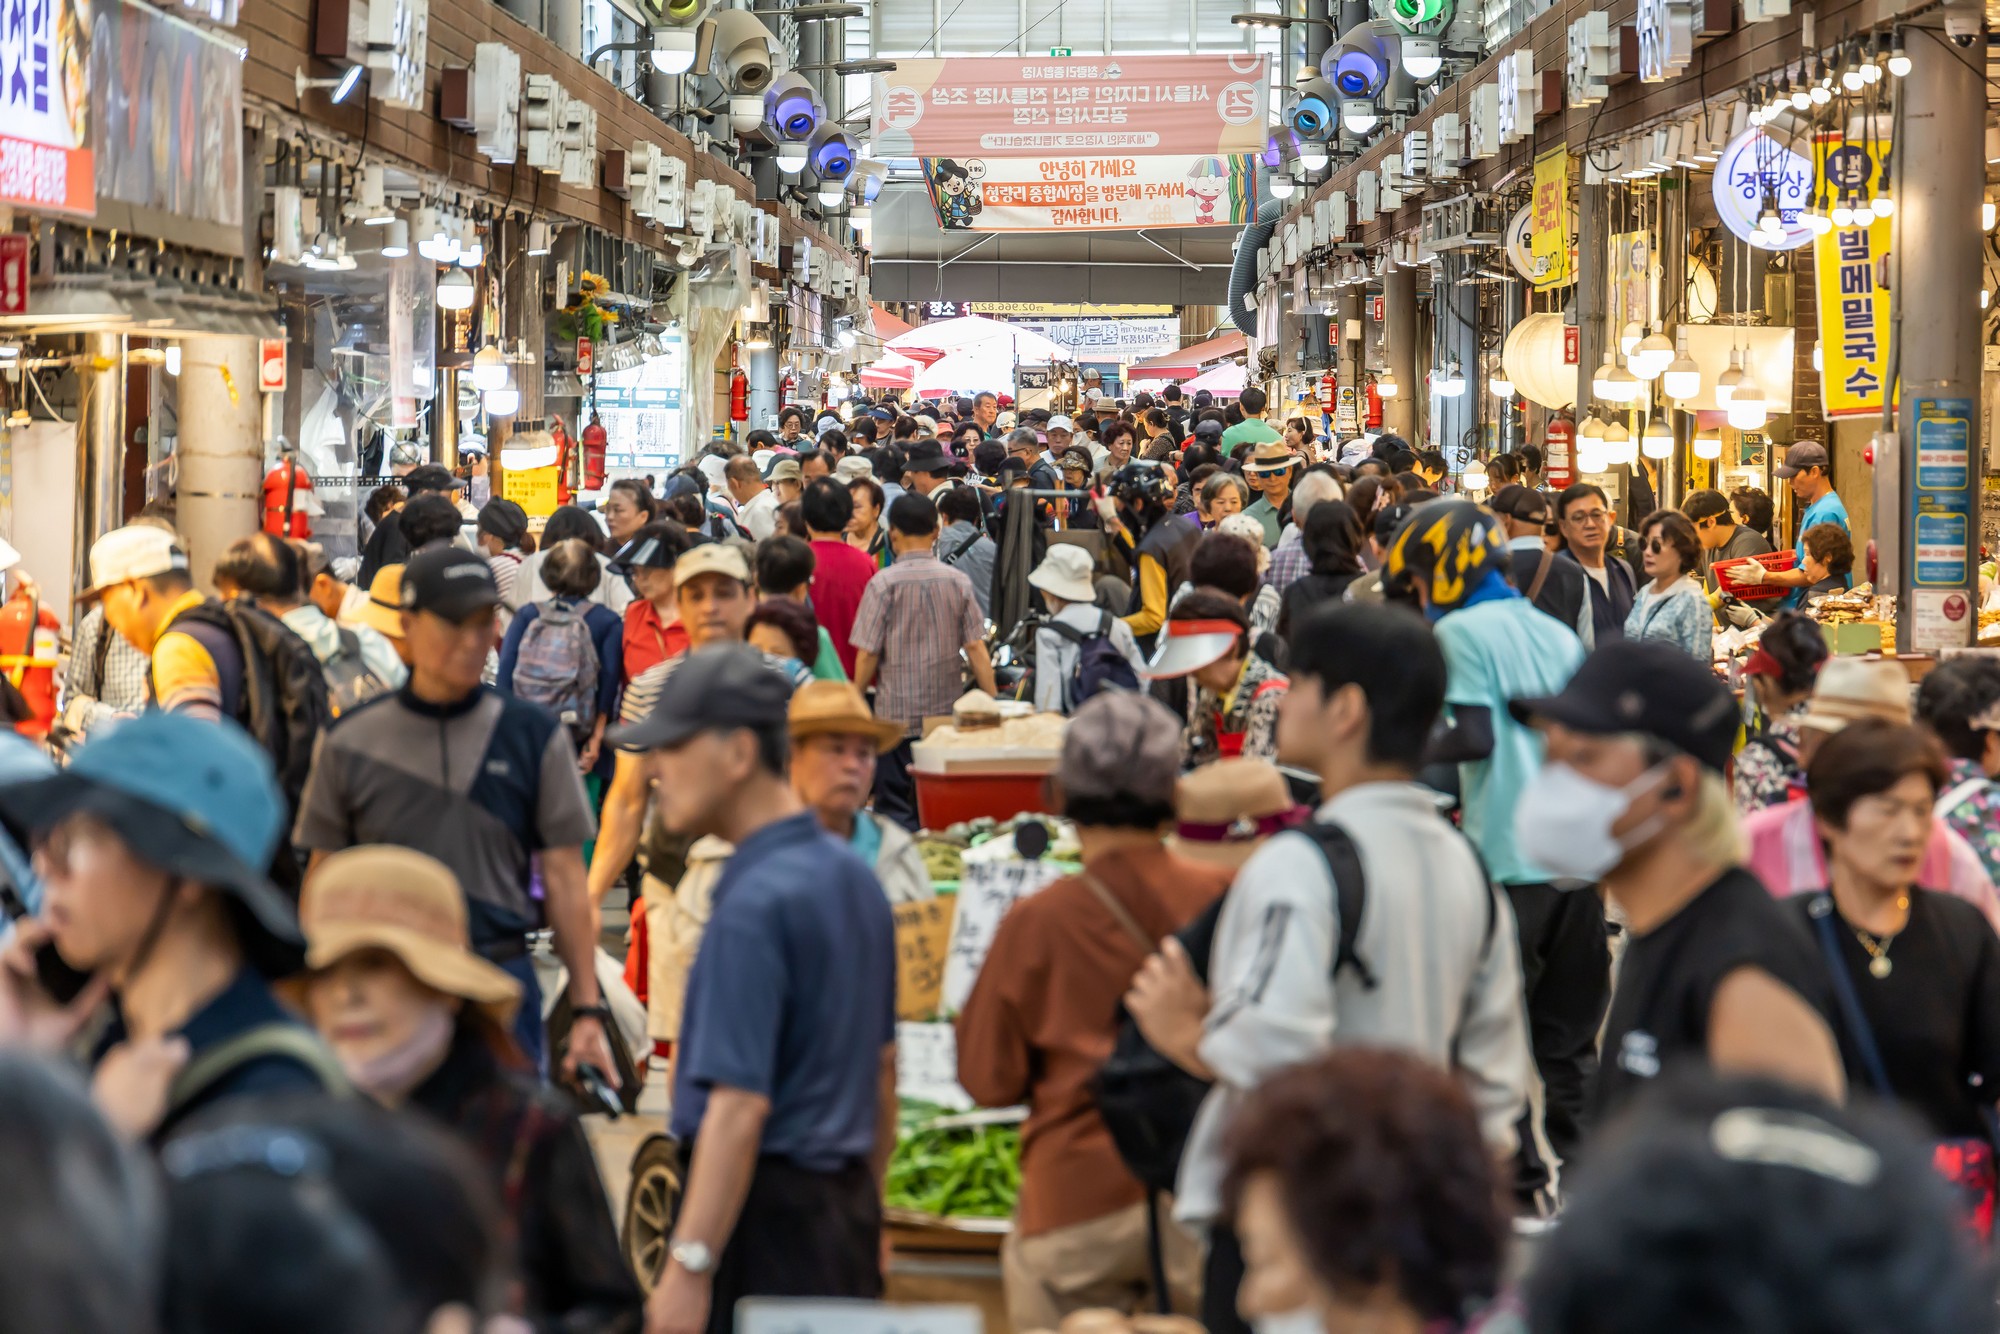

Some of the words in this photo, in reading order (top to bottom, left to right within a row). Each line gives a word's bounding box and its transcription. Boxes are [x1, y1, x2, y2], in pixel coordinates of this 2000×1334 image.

[1039, 160, 1087, 181] 안녕히
[1088, 159, 1137, 179] 가세요
[985, 185, 1027, 204] 청량리
[1029, 184, 1099, 204] 종합시장을
[1101, 183, 1142, 203] 방문해
[1144, 181, 1185, 200] 주셔서
[1736, 170, 1813, 200] 경동상
[1051, 207, 1122, 226] 감사합니다.
[1838, 197, 1880, 398] 빔메밀국수
